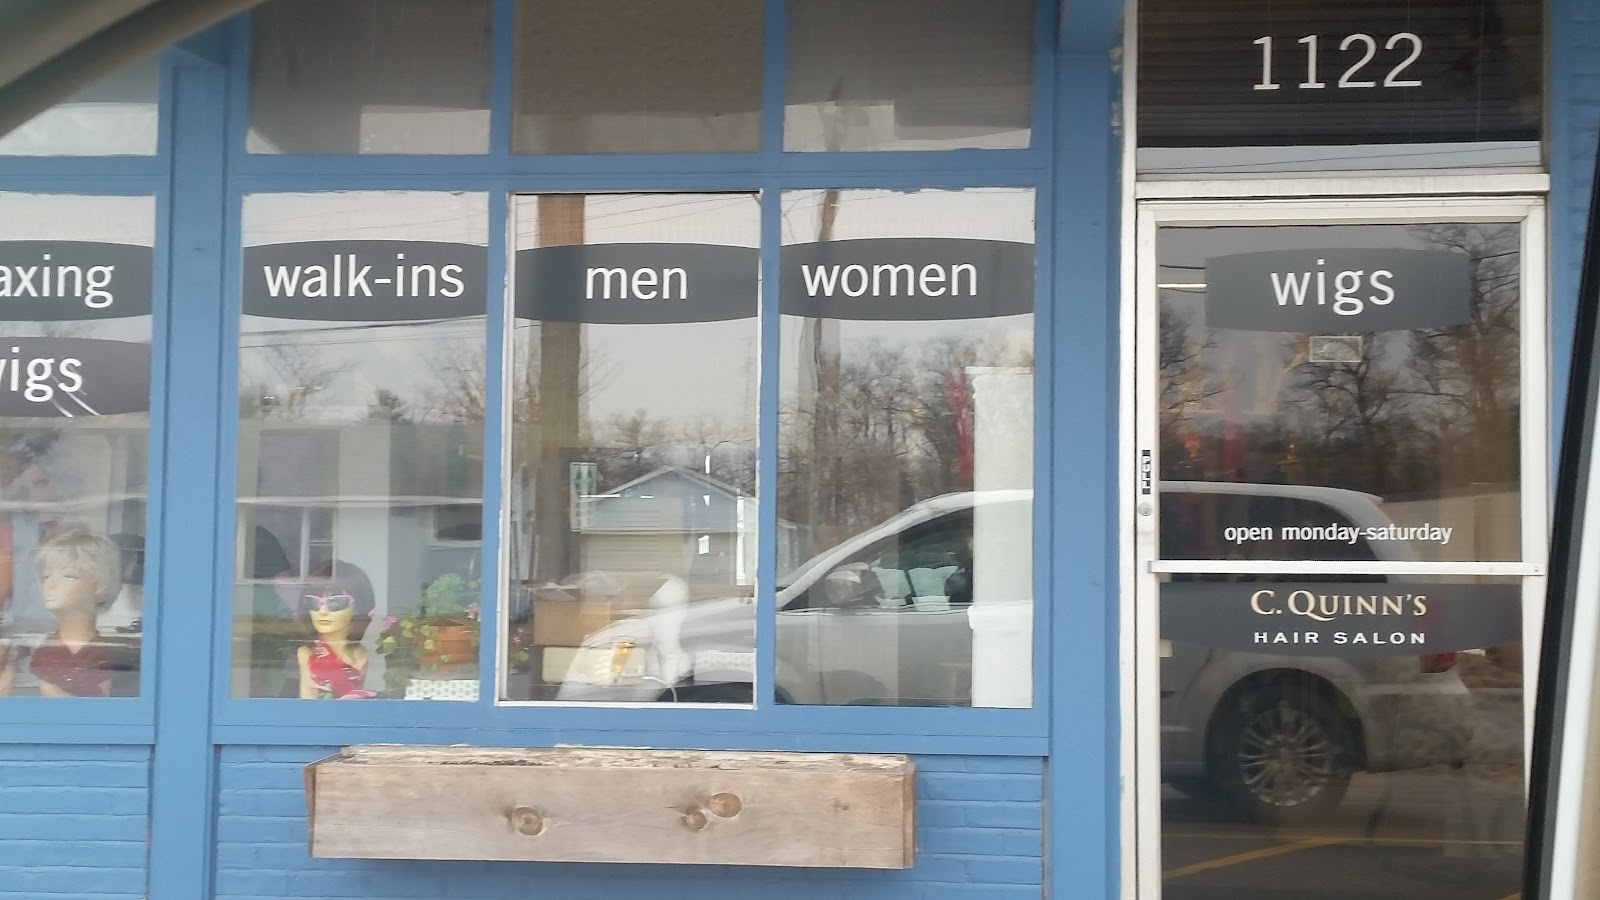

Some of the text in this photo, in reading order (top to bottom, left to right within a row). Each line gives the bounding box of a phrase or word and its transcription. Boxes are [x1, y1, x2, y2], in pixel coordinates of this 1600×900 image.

[1253, 32, 1423, 90] 1122
[263, 253, 465, 299] walk-ins
[585, 266, 688, 301] men
[801, 263, 978, 298] women
[1270, 258, 1395, 316] wigs
[0, 346, 83, 403] igs
[1224, 522, 1453, 545] open monday-saturday
[1254, 631, 1426, 645] HAIR SALON
